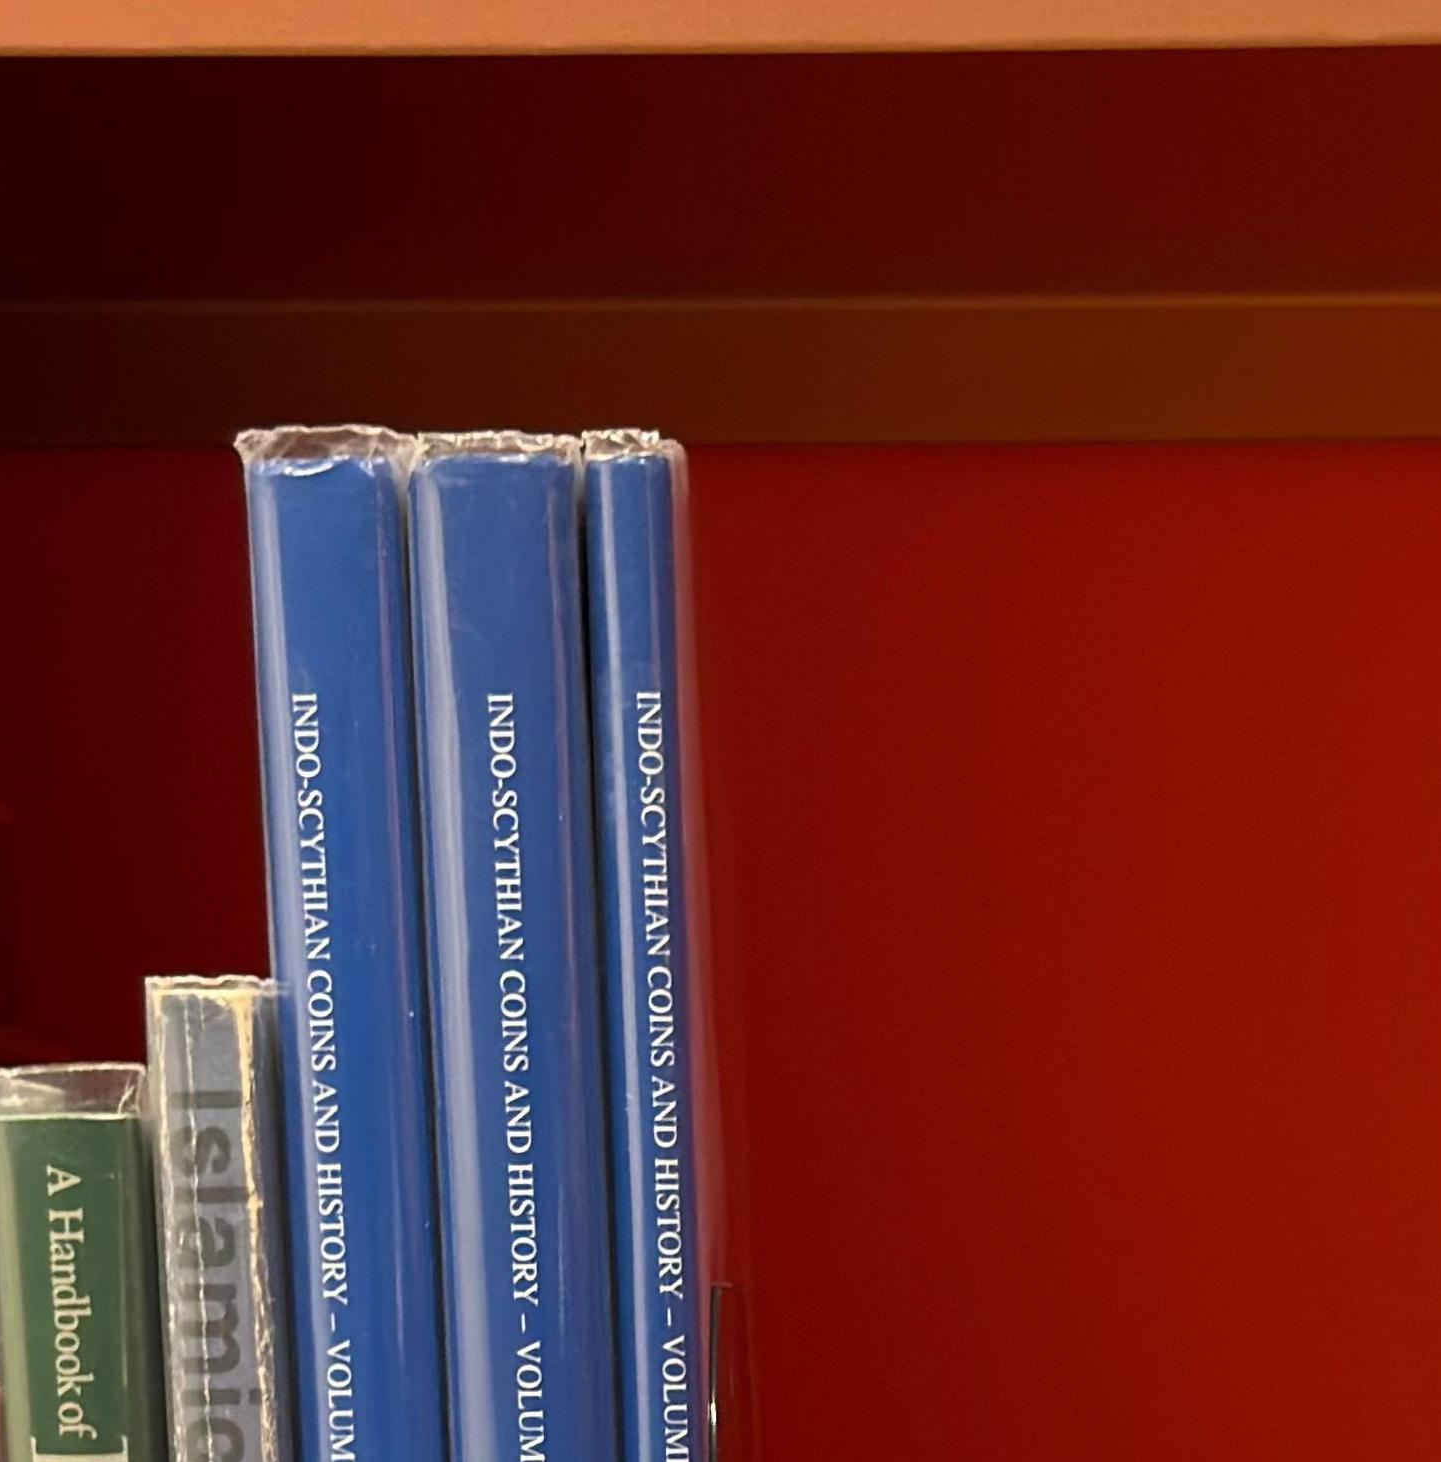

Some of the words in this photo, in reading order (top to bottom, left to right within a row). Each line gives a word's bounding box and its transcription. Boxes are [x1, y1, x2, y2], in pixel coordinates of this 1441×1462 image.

[292, 693, 331, 961] INDO-SCYTHIAN
[488, 693, 523, 960] INDO-SCYTHIAN
[636, 691, 671, 956] INDO-SCYTHIAN
[307, 969, 336, 1072] COINS
[500, 969, 529, 1073] COINS
[647, 964, 676, 1068] COINS
[312, 1080, 340, 1154] AND
[504, 1080, 532, 1154] AND
[651, 1075, 677, 1149] AND
[46, 1165, 81, 1196] A
[654, 1158, 684, 1300] HISTORY
[317, 1163, 348, 1305] HISTORY
[507, 1162, 538, 1306] HISTORY
[48, 1208, 94, 1397] Handbook
[58, 1401, 97, 1440] of
